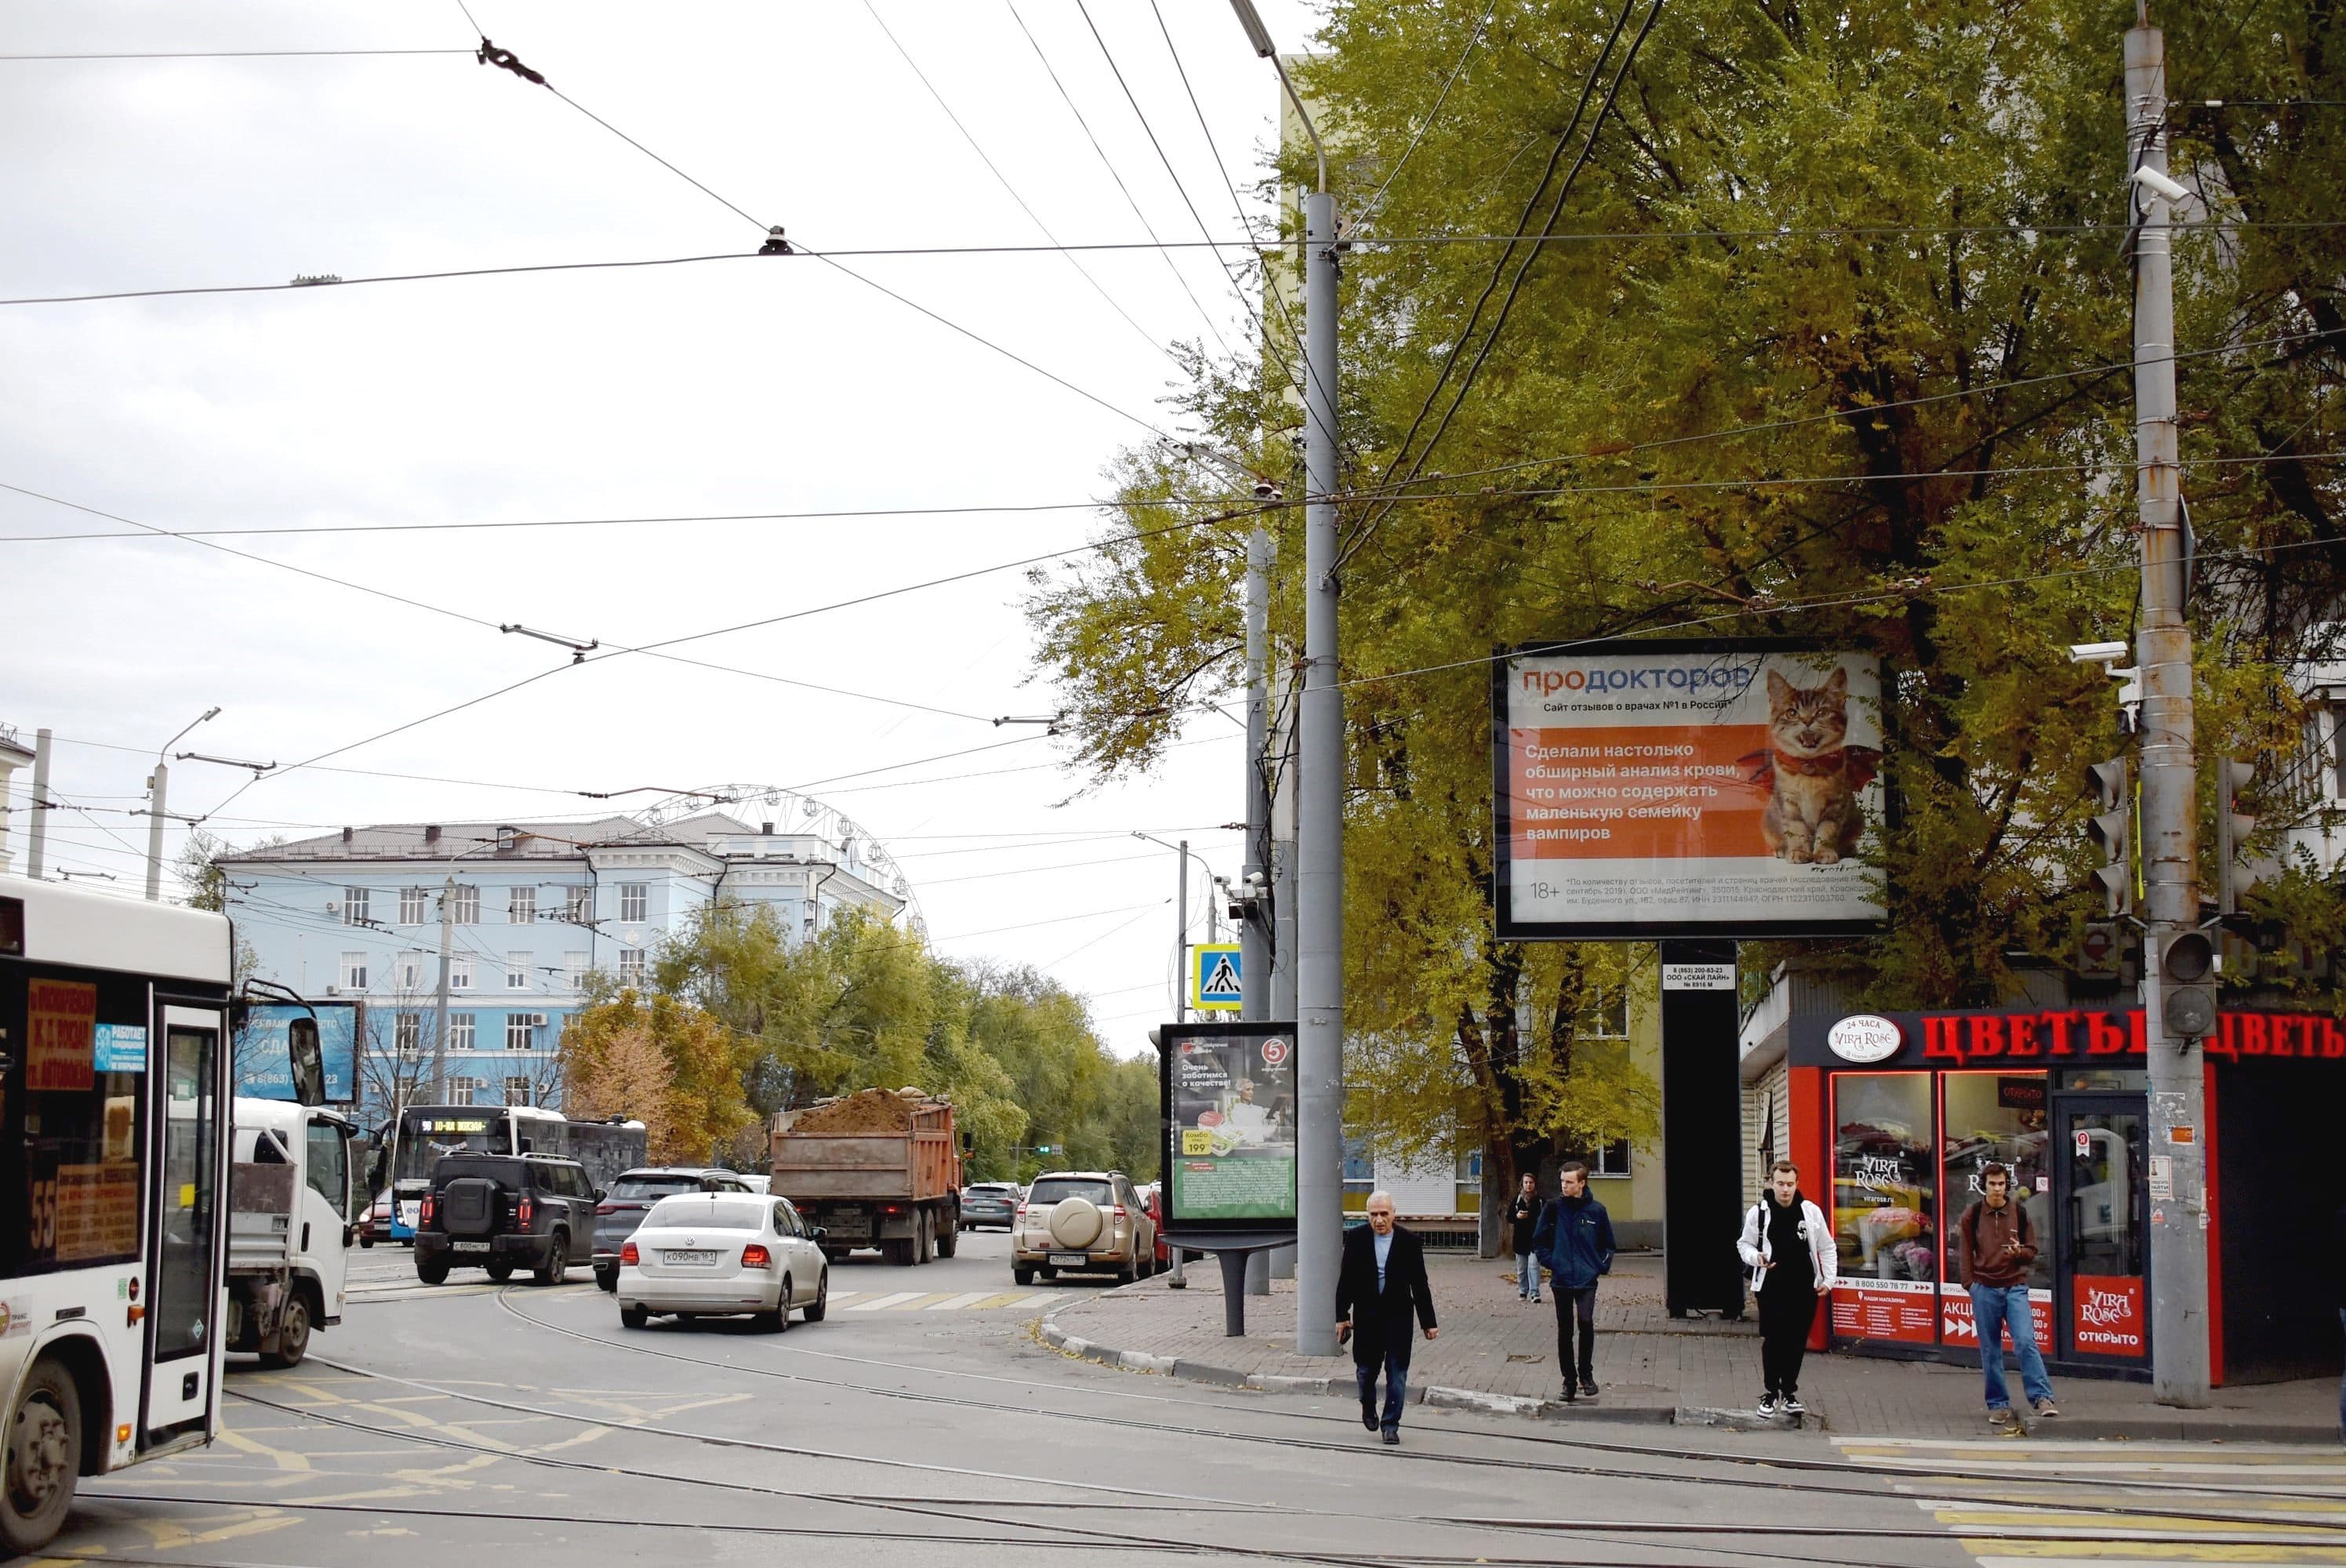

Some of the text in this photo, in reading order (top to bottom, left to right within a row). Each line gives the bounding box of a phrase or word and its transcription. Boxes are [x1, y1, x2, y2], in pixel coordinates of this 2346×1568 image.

[1523, 666, 1751, 697] продокторов
[1544, 702, 1568, 712] Сайт
[1625, 703, 1661, 713] врачах
[1525, 745, 1694, 760] Сделали настолько
[1525, 764, 1741, 781] обширный анализ крови,
[1526, 785, 1718, 800] что можно содержать
[1526, 804, 1701, 822] маленькую семейку
[1526, 828, 1611, 842] вампиров
[1760, 877, 1788, 885] врачей
[1531, 882, 1560, 899] 18+
[1567, 887, 1602, 896] сентябрь
[1744, 885, 1804, 894] Краснодарский
[1858, 1020, 1880, 1029] ЧАСА
[1922, 1010, 2147, 1065] ЦВЕТЫ
[1188, 1143, 1205, 1152] 199
[1863, 1153, 1901, 1182] VIRA
[32, 1180, 56, 1248] 55
[2089, 1287, 2132, 1317] VIRA
[2081, 1305, 2120, 1326] ROSE
[2079, 1330, 2138, 1345] ОТКРЫТО
